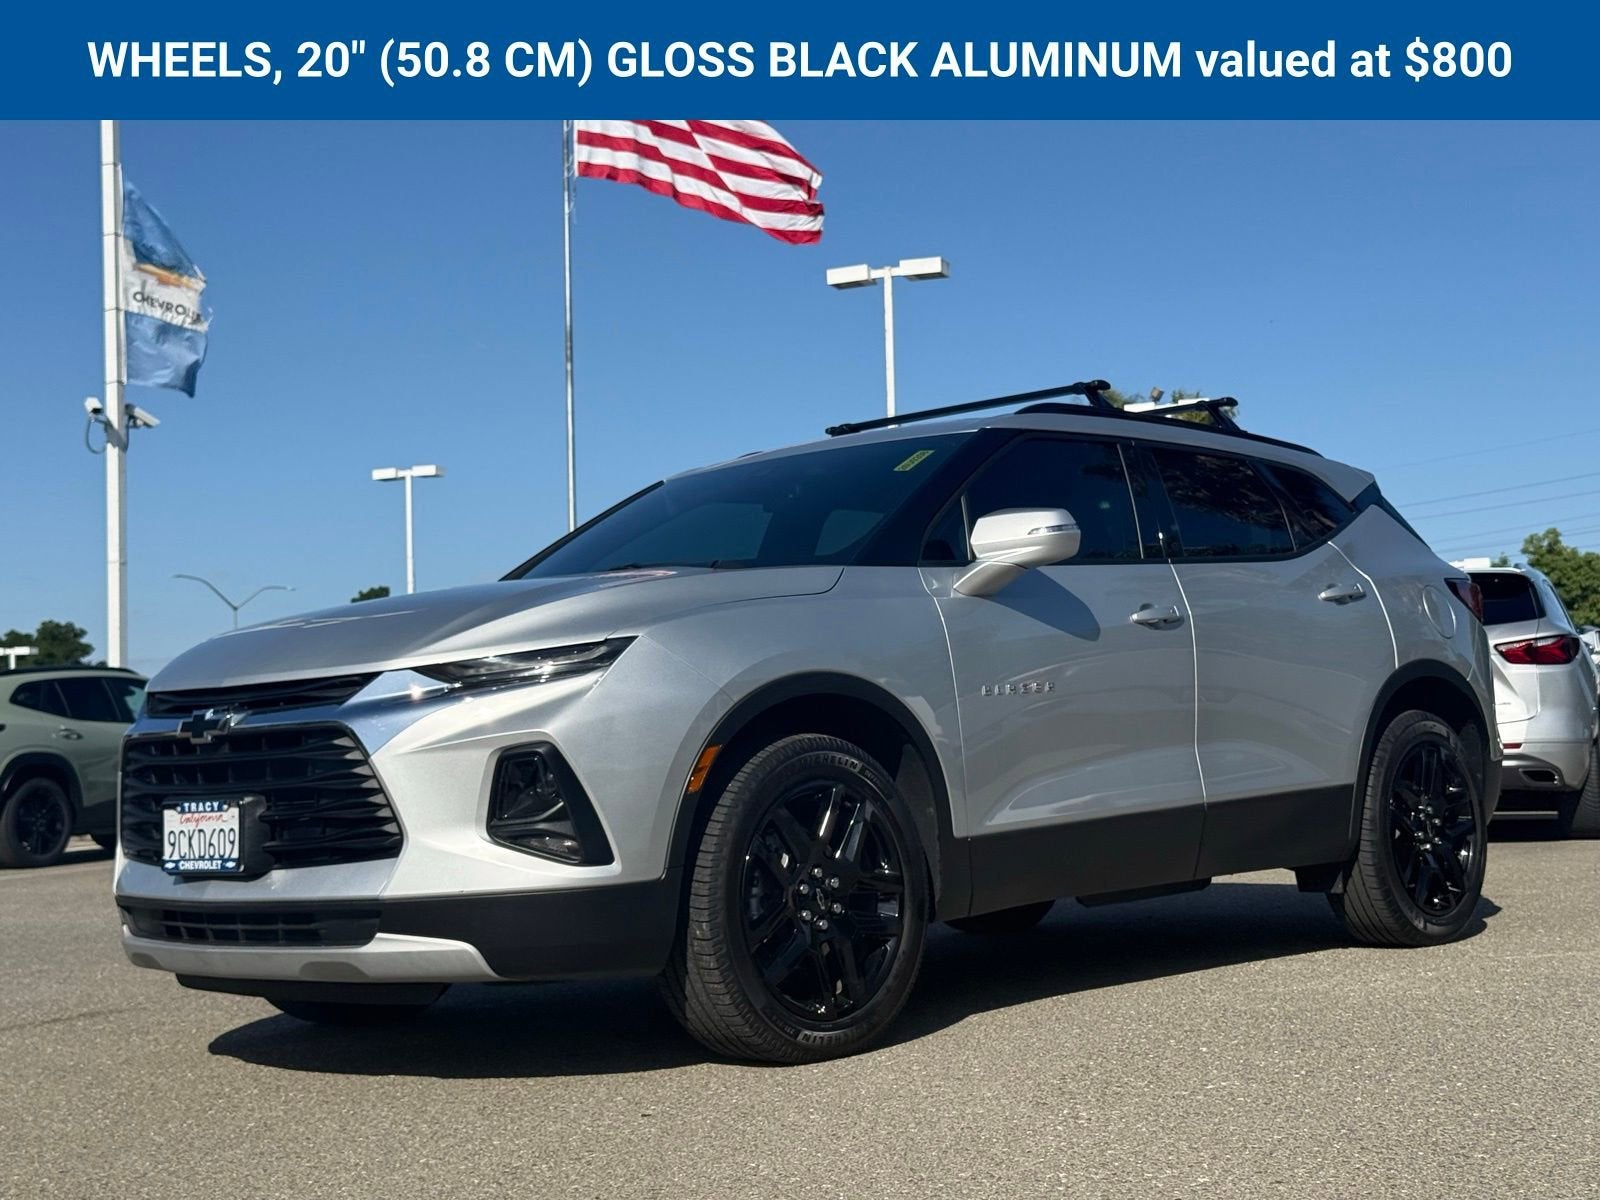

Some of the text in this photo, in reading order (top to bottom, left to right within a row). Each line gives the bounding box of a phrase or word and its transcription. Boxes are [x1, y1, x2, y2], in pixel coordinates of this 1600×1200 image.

[183, 802, 220, 812] TRACY
[179, 812, 228, 828] California
[167, 827, 237, 860] 9CKD609
[178, 859, 223, 871] CHEVROLET
